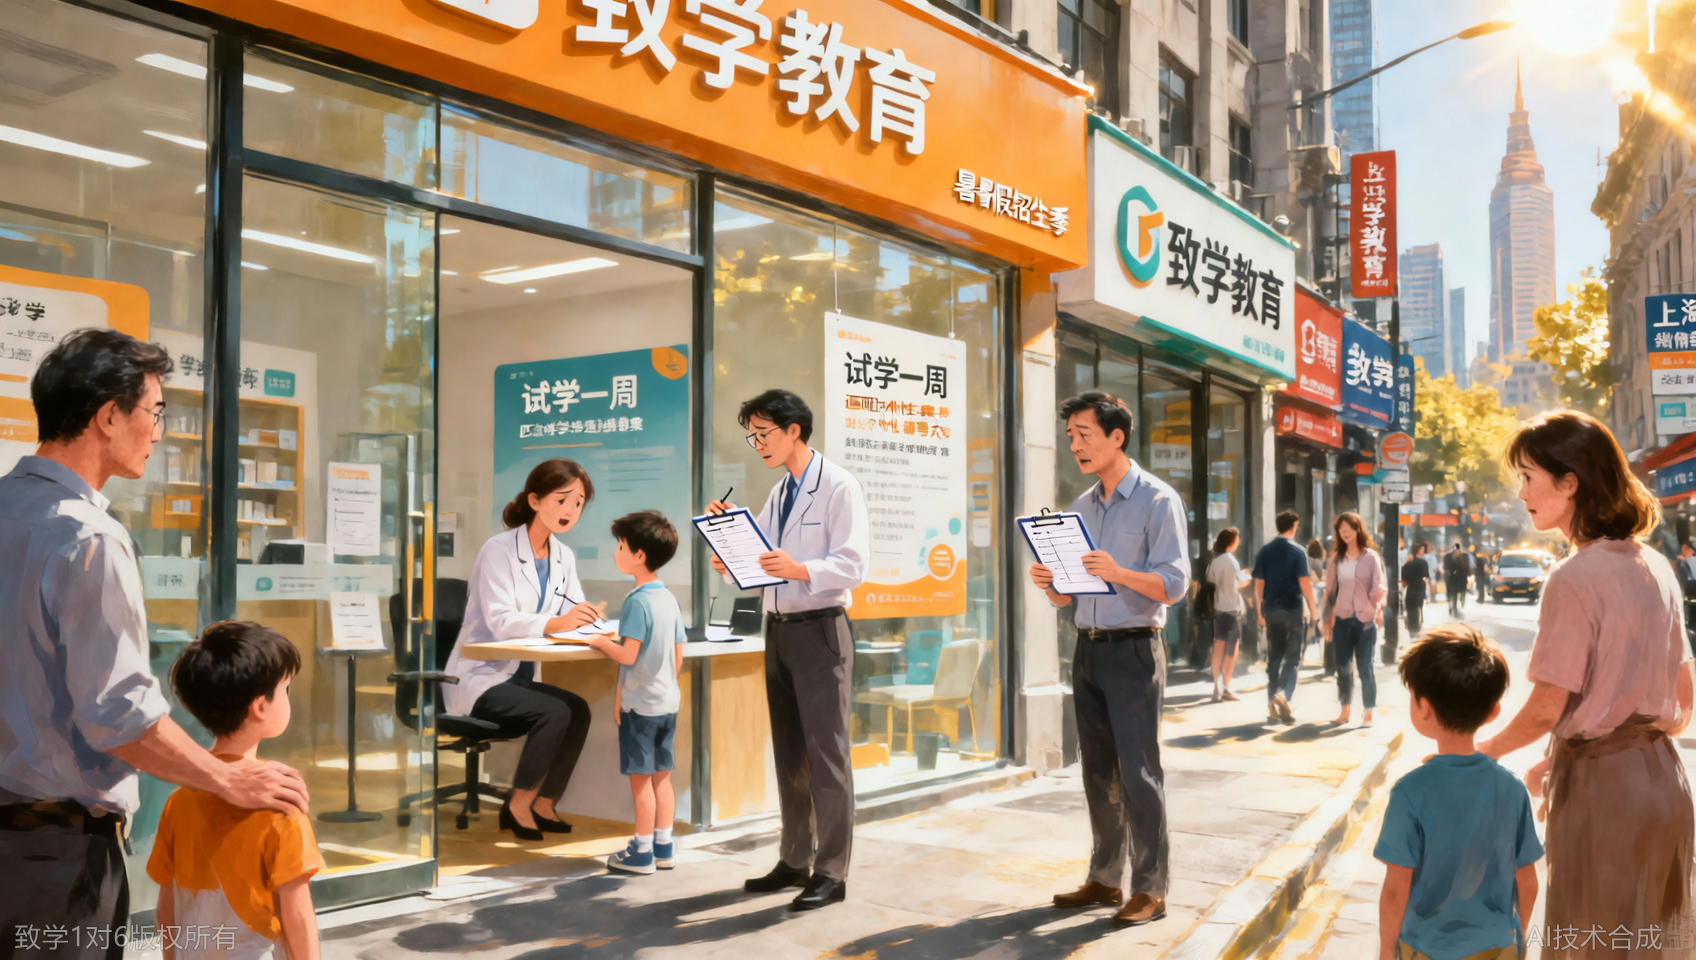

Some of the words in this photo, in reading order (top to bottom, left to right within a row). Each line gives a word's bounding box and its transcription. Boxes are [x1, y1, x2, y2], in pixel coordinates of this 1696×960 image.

[1166, 220, 1284, 330] 致学教育
[521, 374, 638, 415] 试学一周
[844, 351, 948, 399] 试学一周
